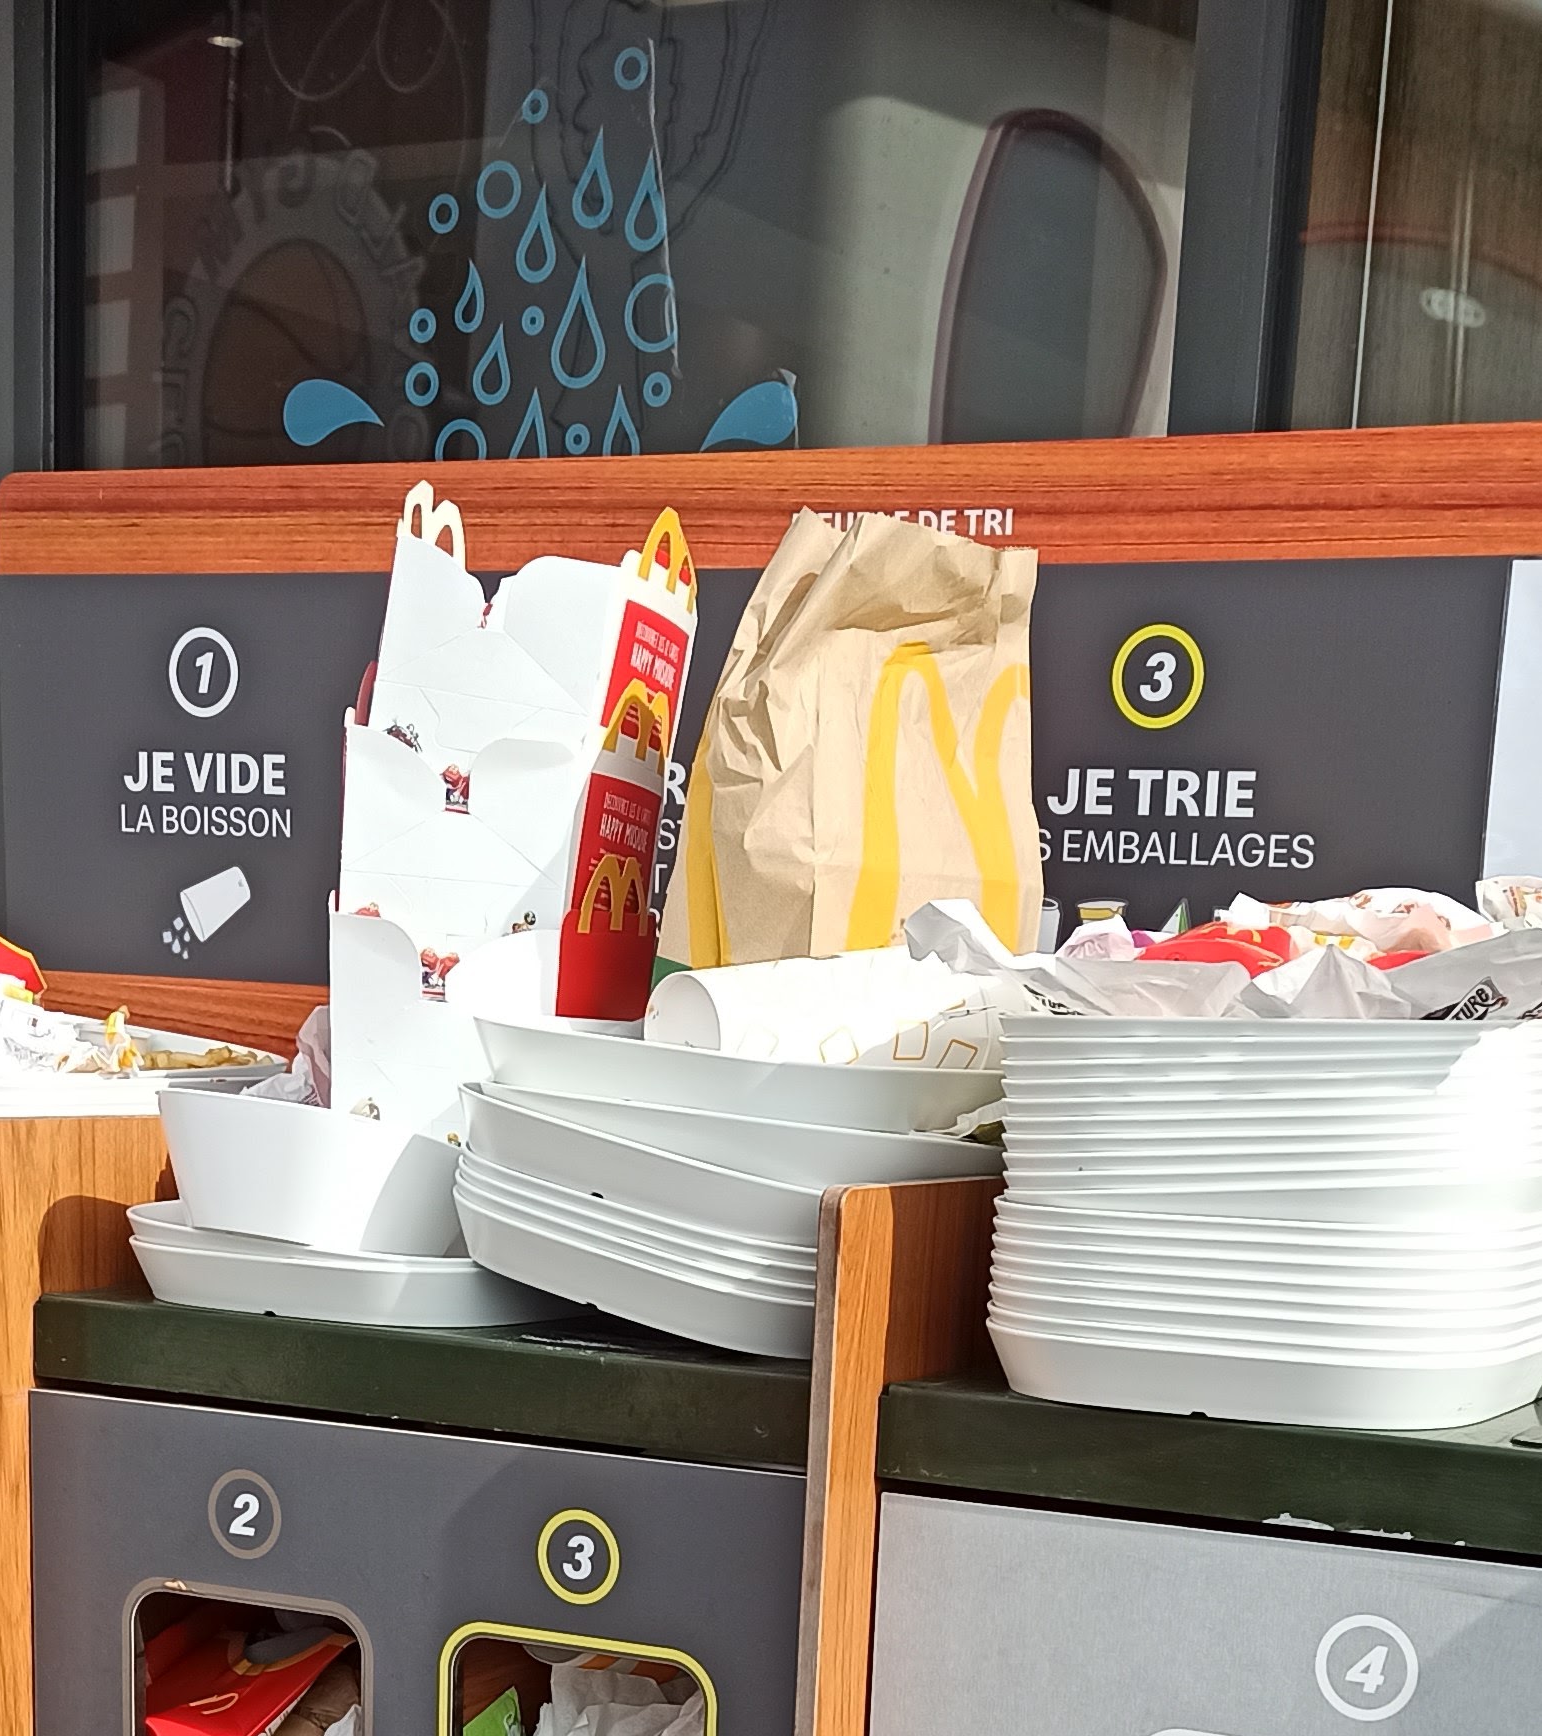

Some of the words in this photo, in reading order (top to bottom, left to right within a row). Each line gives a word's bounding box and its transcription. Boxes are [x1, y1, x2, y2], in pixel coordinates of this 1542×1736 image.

[918, 510, 956, 536] DE
[964, 508, 1013, 536] TRI
[195, 651, 214, 694] 1
[1139, 651, 1177, 702] 3
[123, 751, 175, 792] JE
[184, 752, 286, 796] VIDE
[1046, 768, 1115, 815] JE
[1128, 769, 1257, 818] TRIE
[120, 803, 155, 834] LA
[162, 805, 292, 838] BOISSON
[1062, 829, 1315, 869] EMBALLAGES
[228, 1493, 260, 1537] 2
[562, 1534, 595, 1581] 3
[1345, 1645, 1390, 1695] 4
